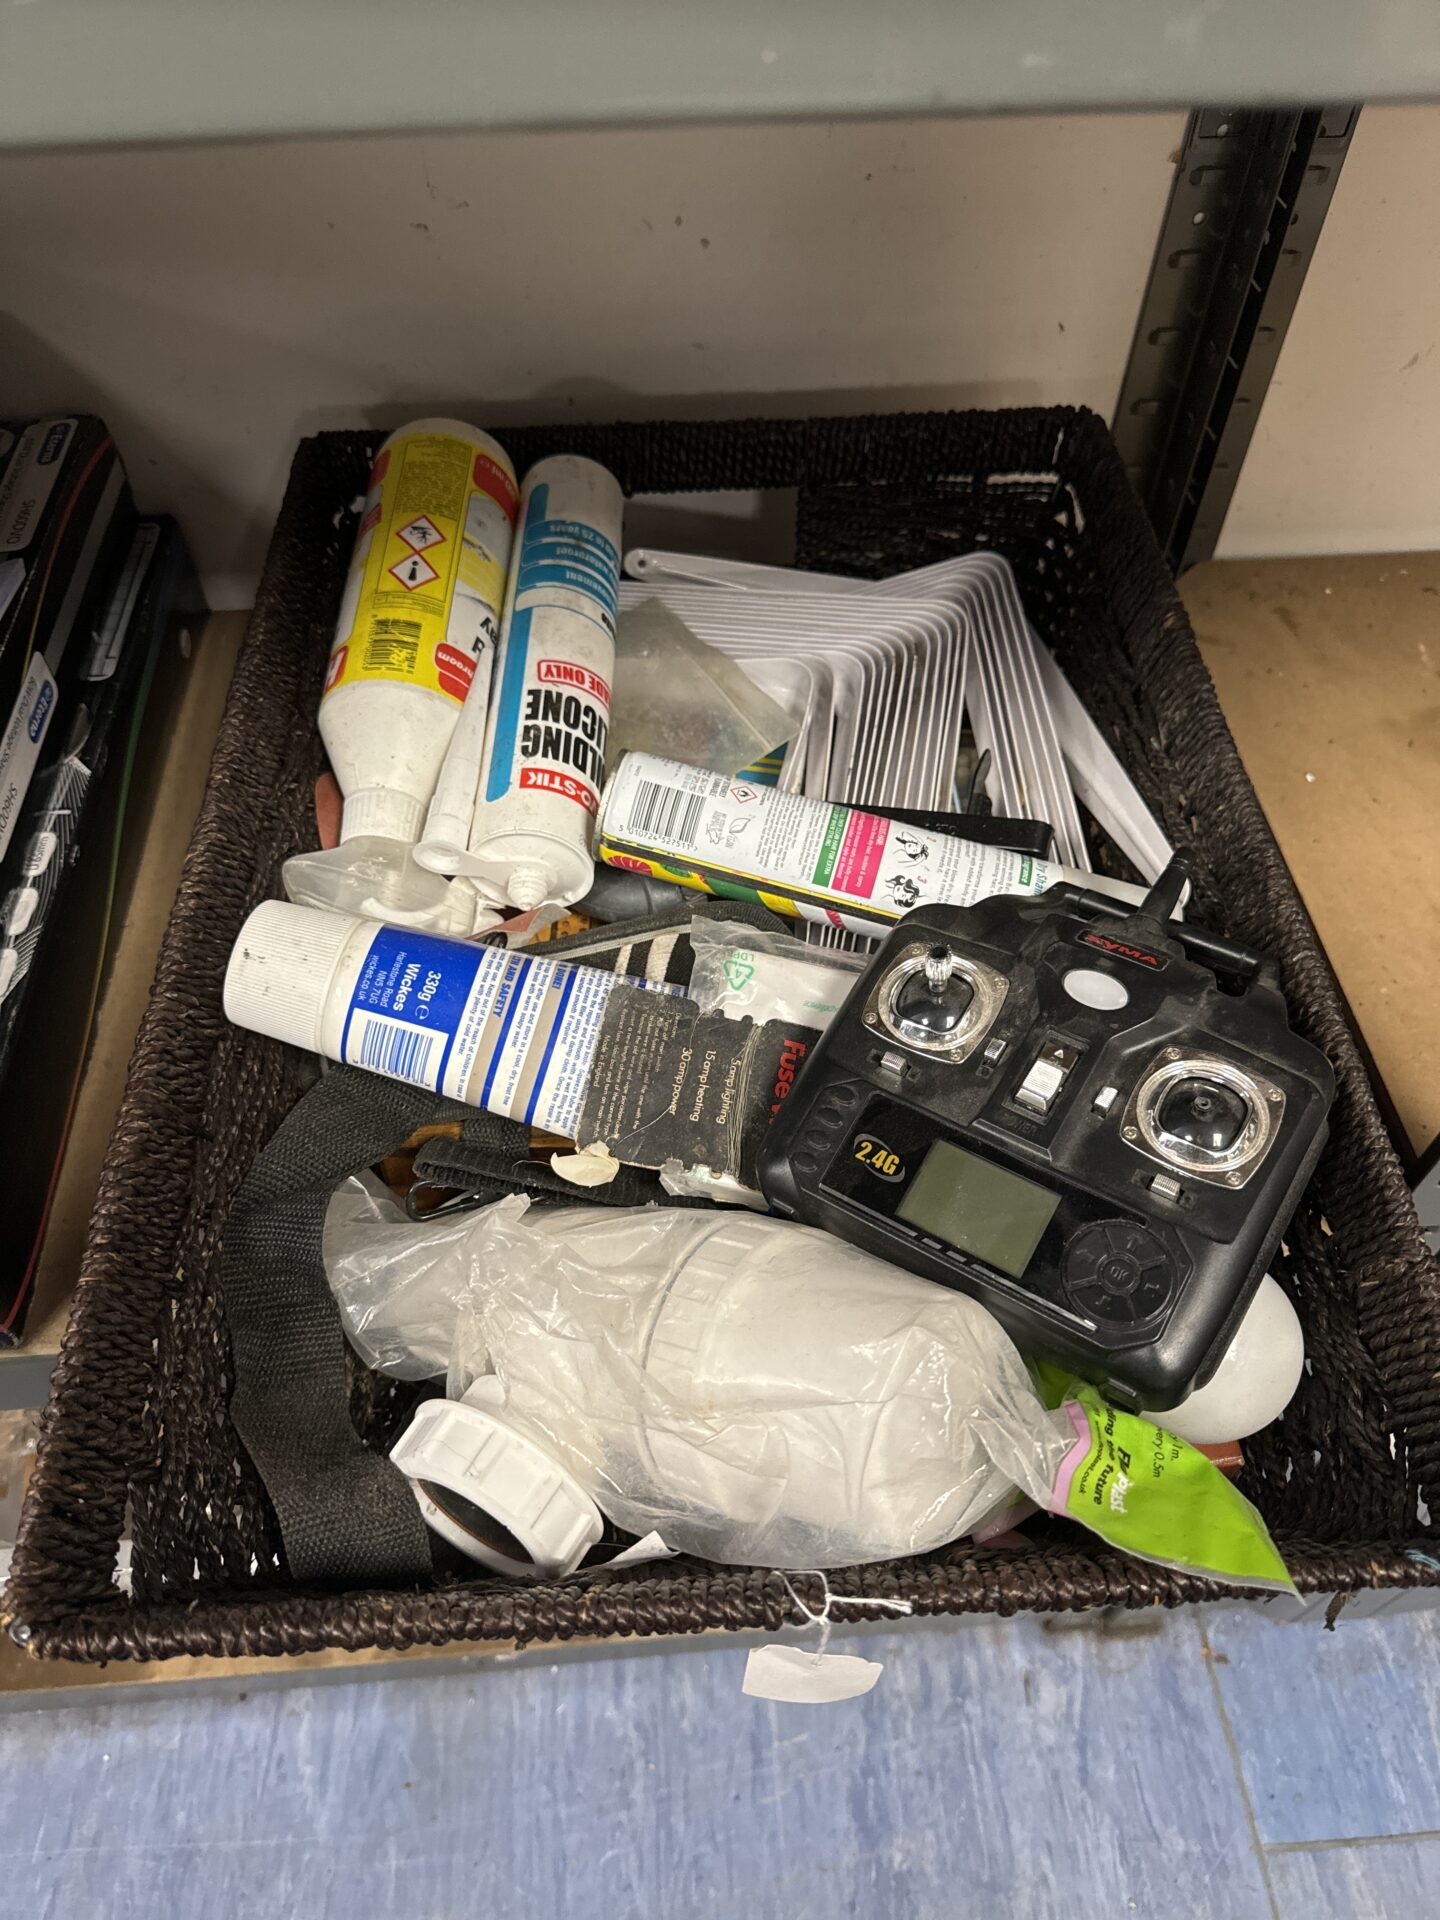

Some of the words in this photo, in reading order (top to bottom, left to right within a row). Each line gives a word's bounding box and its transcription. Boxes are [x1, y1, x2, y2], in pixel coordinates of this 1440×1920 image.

[543, 665, 585, 685] ONLY
[520, 727, 606, 786] ILDING
[356, 953, 379, 1001] wickes.co.uk
[374, 969, 387, 987] NN5
[387, 950, 406, 984] Harlestone
[503, 964, 516, 982] AND
[368, 986, 381, 1004] 7UG
[392, 962, 420, 1011] Wickes
[417, 969, 441, 1002] 330g
[484, 982, 495, 998] Keep
[379, 987, 393, 1008] Road
[469, 996, 481, 1015] plenty
[491, 982, 510, 1018] SAFETY
[569, 993, 581, 1014] smooth
[469, 1027, 480, 1045] reach
[521, 1024, 531, 1041] store
[600, 1034, 610, 1053] Made
[572, 1038, 585, 1061] smooth
[680, 1046, 692, 1062] 30
[704, 1049, 716, 1060] 15
[592, 1060, 605, 1088] England
[673, 1061, 686, 1084] amp
[697, 1060, 711, 1083] amp
[723, 1064, 737, 1087] amp
[774, 1038, 807, 1099] Fuse
[554, 1075, 566, 1092] Once
[570, 1068, 585, 1094] Squeeze
[666, 1084, 681, 1115] power
[688, 1083, 708, 1121] heating
[715, 1087, 734, 1124] lighting
[854, 1140, 900, 1175] 2.4G
[1109, 1265, 1129, 1281] OK
[1151, 1450, 1164, 1478] 0.5m
[1093, 1464, 1115, 1505] future
